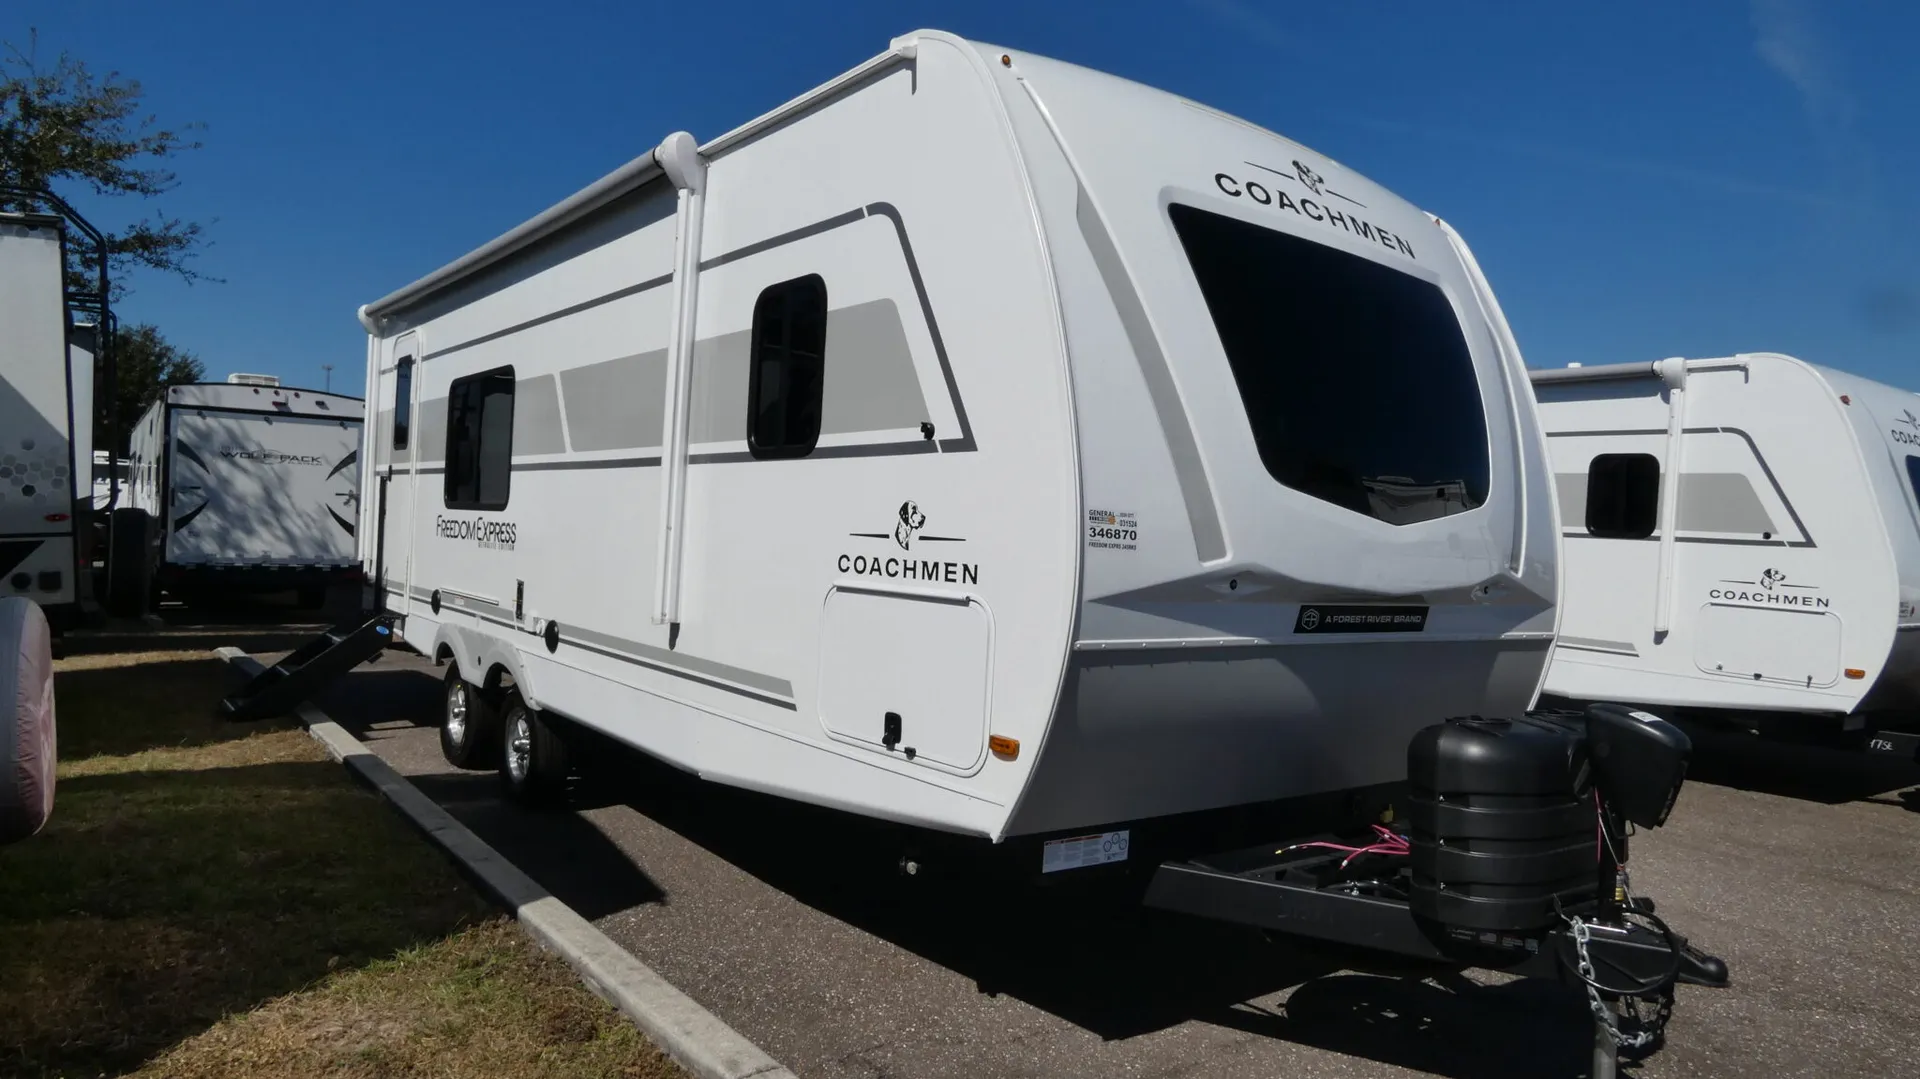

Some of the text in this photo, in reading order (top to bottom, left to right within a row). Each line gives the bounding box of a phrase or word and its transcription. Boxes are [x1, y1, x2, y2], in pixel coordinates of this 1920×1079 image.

[1214, 173, 1416, 259] COACHMEN
[280, 454, 321, 463] PACK
[1089, 527, 1137, 540] 346870
[837, 554, 978, 585] COACHMEN
[1709, 589, 1830, 608] COACHMEN
[1325, 615, 1422, 624] A FOREST RIVER BRAND
